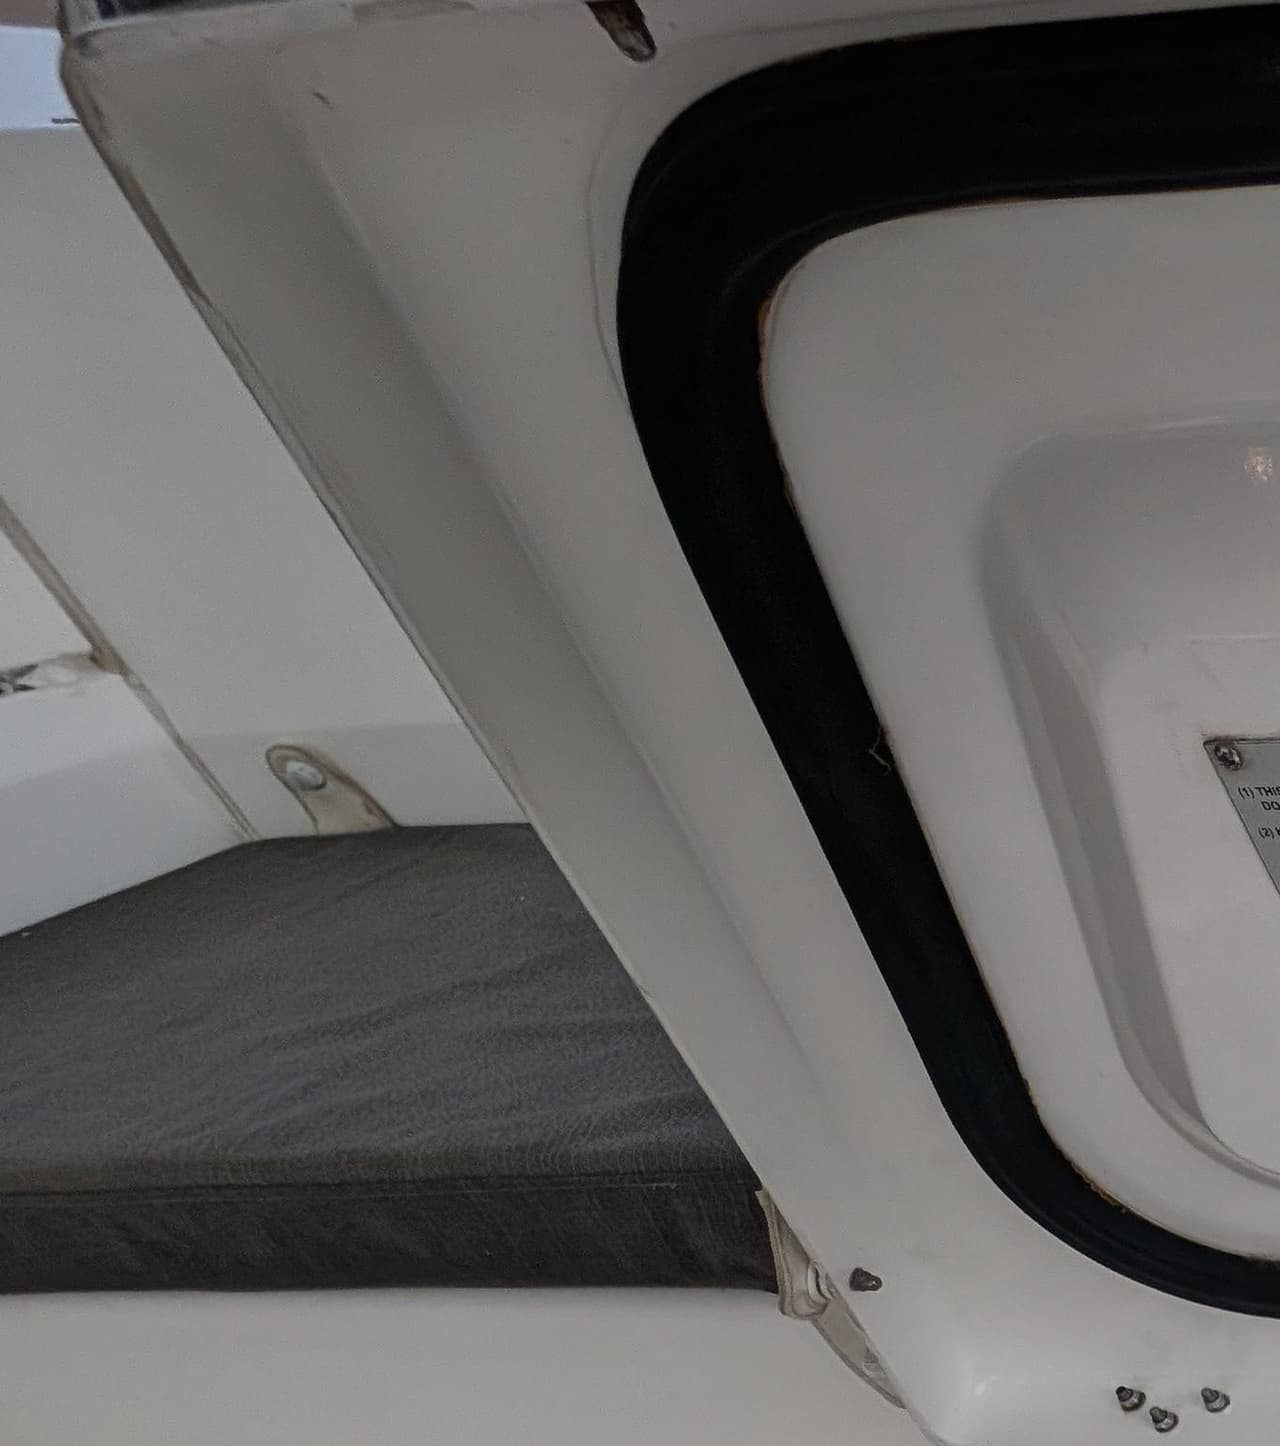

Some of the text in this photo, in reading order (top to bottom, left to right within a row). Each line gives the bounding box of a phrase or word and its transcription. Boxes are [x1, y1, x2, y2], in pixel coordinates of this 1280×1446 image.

[1238, 786, 1255, 800] (1)
[1261, 801, 1280, 811] DO
[1258, 827, 1275, 839] (2)
